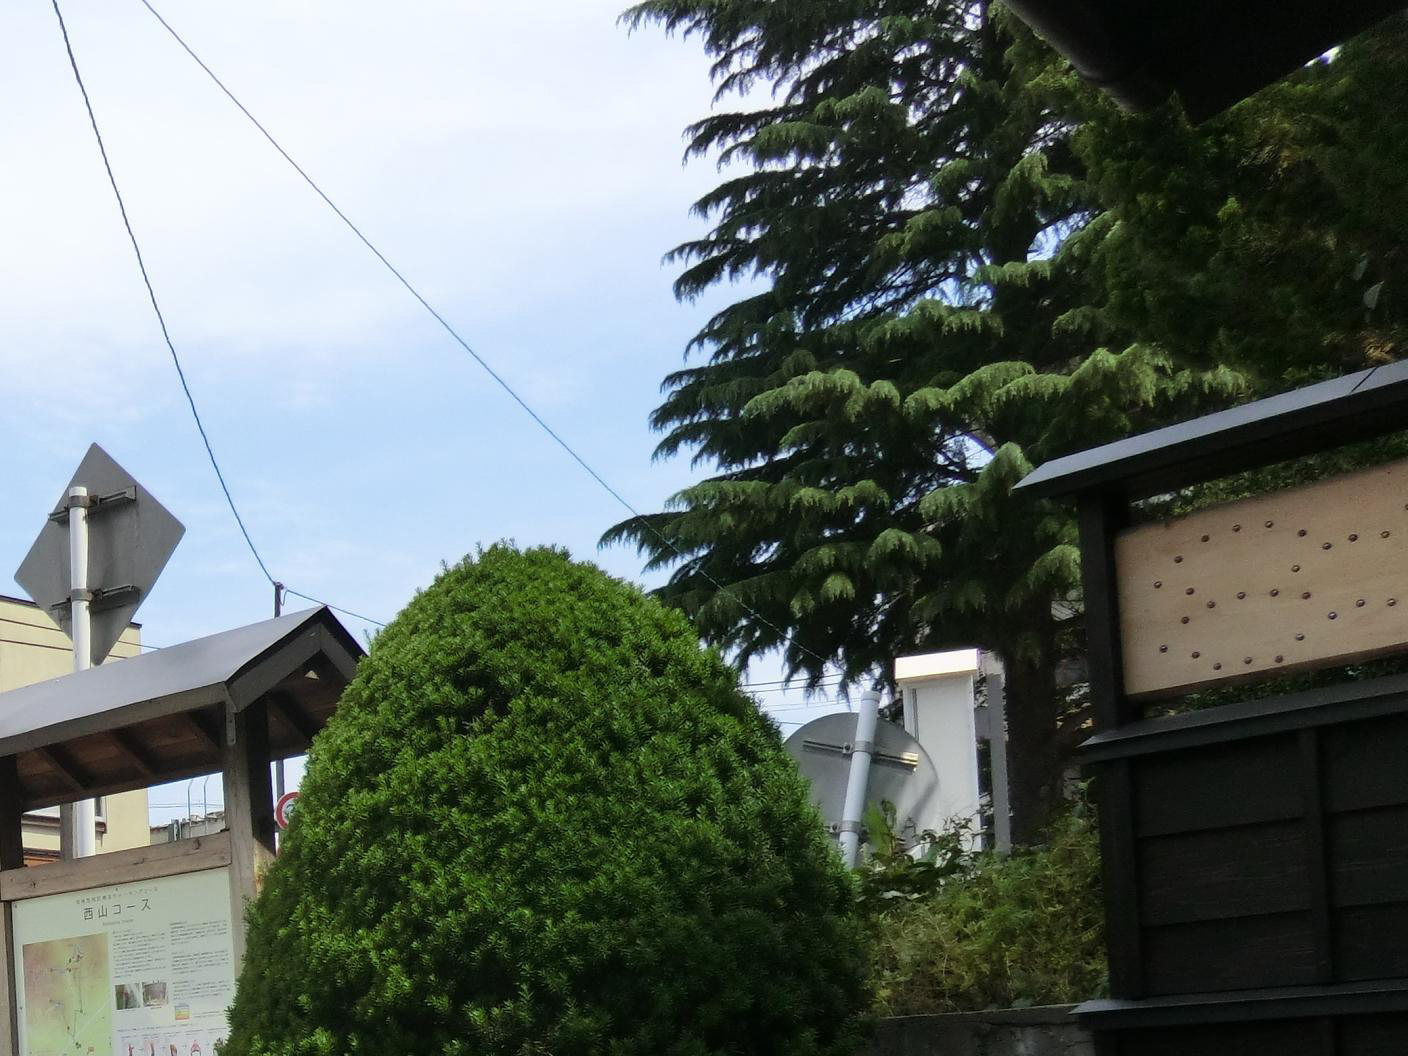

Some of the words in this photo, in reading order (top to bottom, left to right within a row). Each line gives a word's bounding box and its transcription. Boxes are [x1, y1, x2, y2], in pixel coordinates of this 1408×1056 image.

[83, 898, 152, 921] 西山コース
